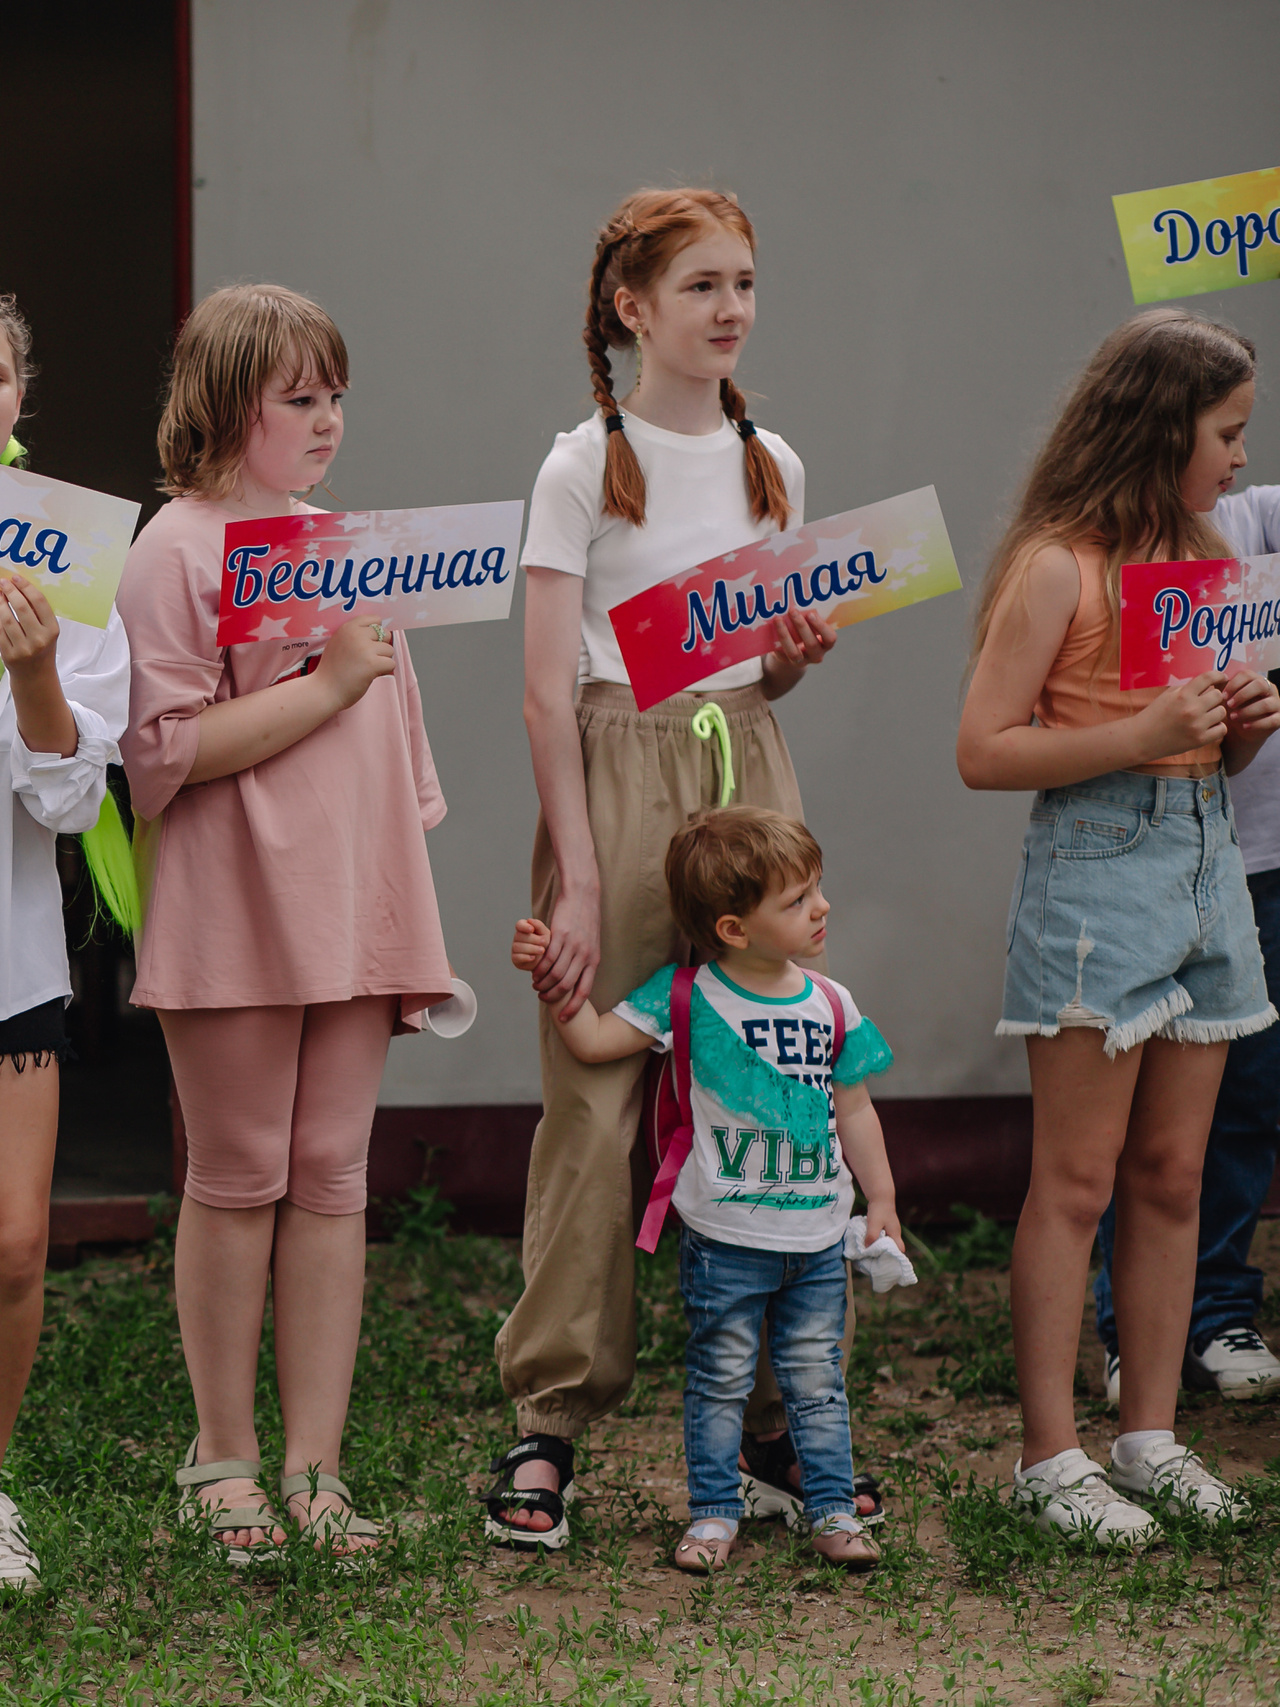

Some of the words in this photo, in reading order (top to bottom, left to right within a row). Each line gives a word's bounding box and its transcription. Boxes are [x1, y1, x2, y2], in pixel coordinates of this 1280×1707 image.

[227, 544, 510, 612] Бесценная
[682, 550, 887, 652] Милая
[281, 644, 291, 652] no
[291, 641, 309, 649] more
[713, 1182, 747, 1208] The
